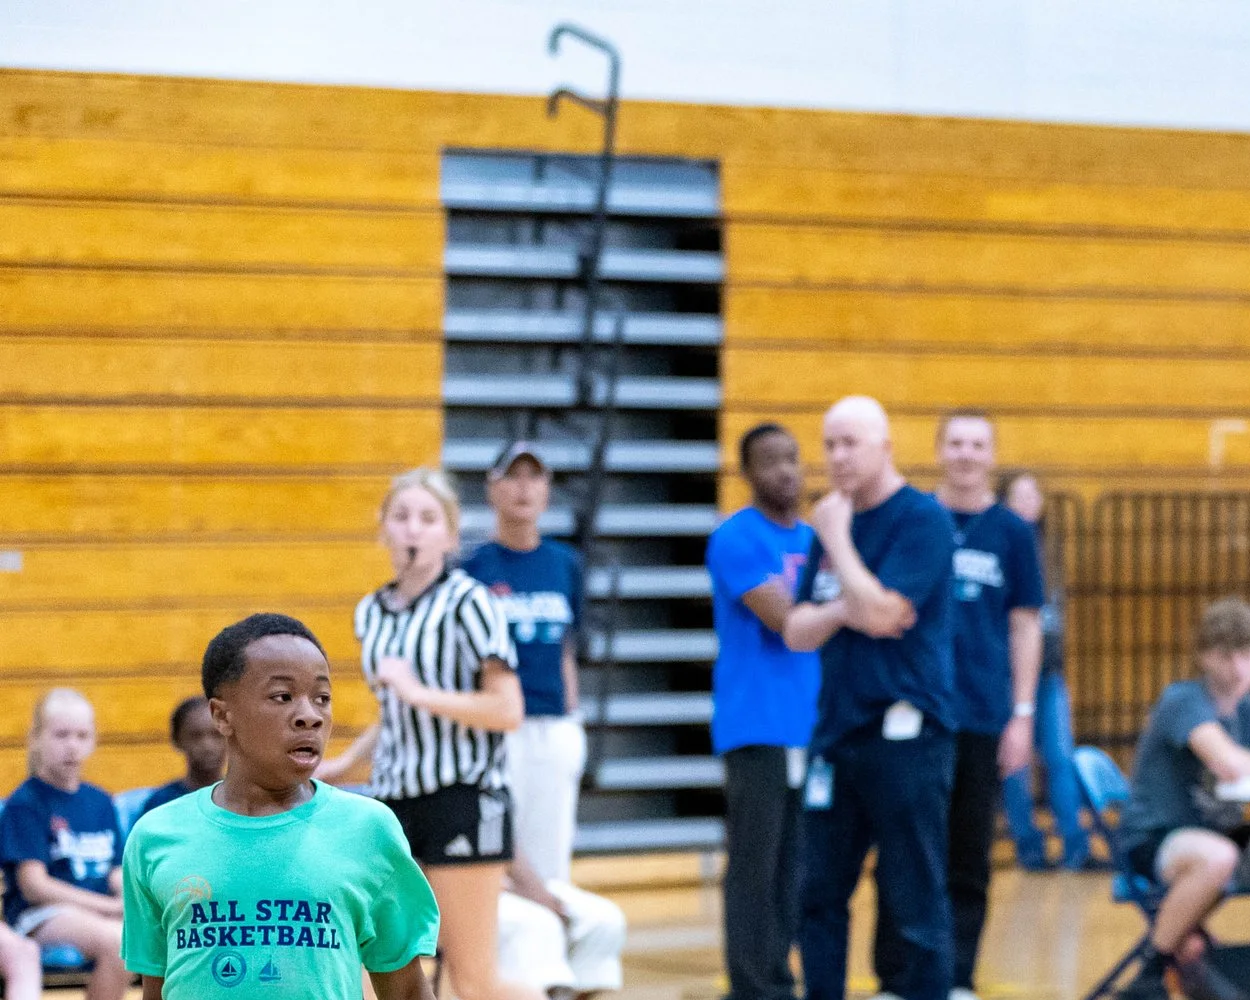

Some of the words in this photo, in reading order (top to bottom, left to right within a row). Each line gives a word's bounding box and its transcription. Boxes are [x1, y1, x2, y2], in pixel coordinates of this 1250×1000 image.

[190, 900, 246, 924] ALL
[255, 899, 332, 924] STAR
[176, 925, 341, 949] BASKETBALL
